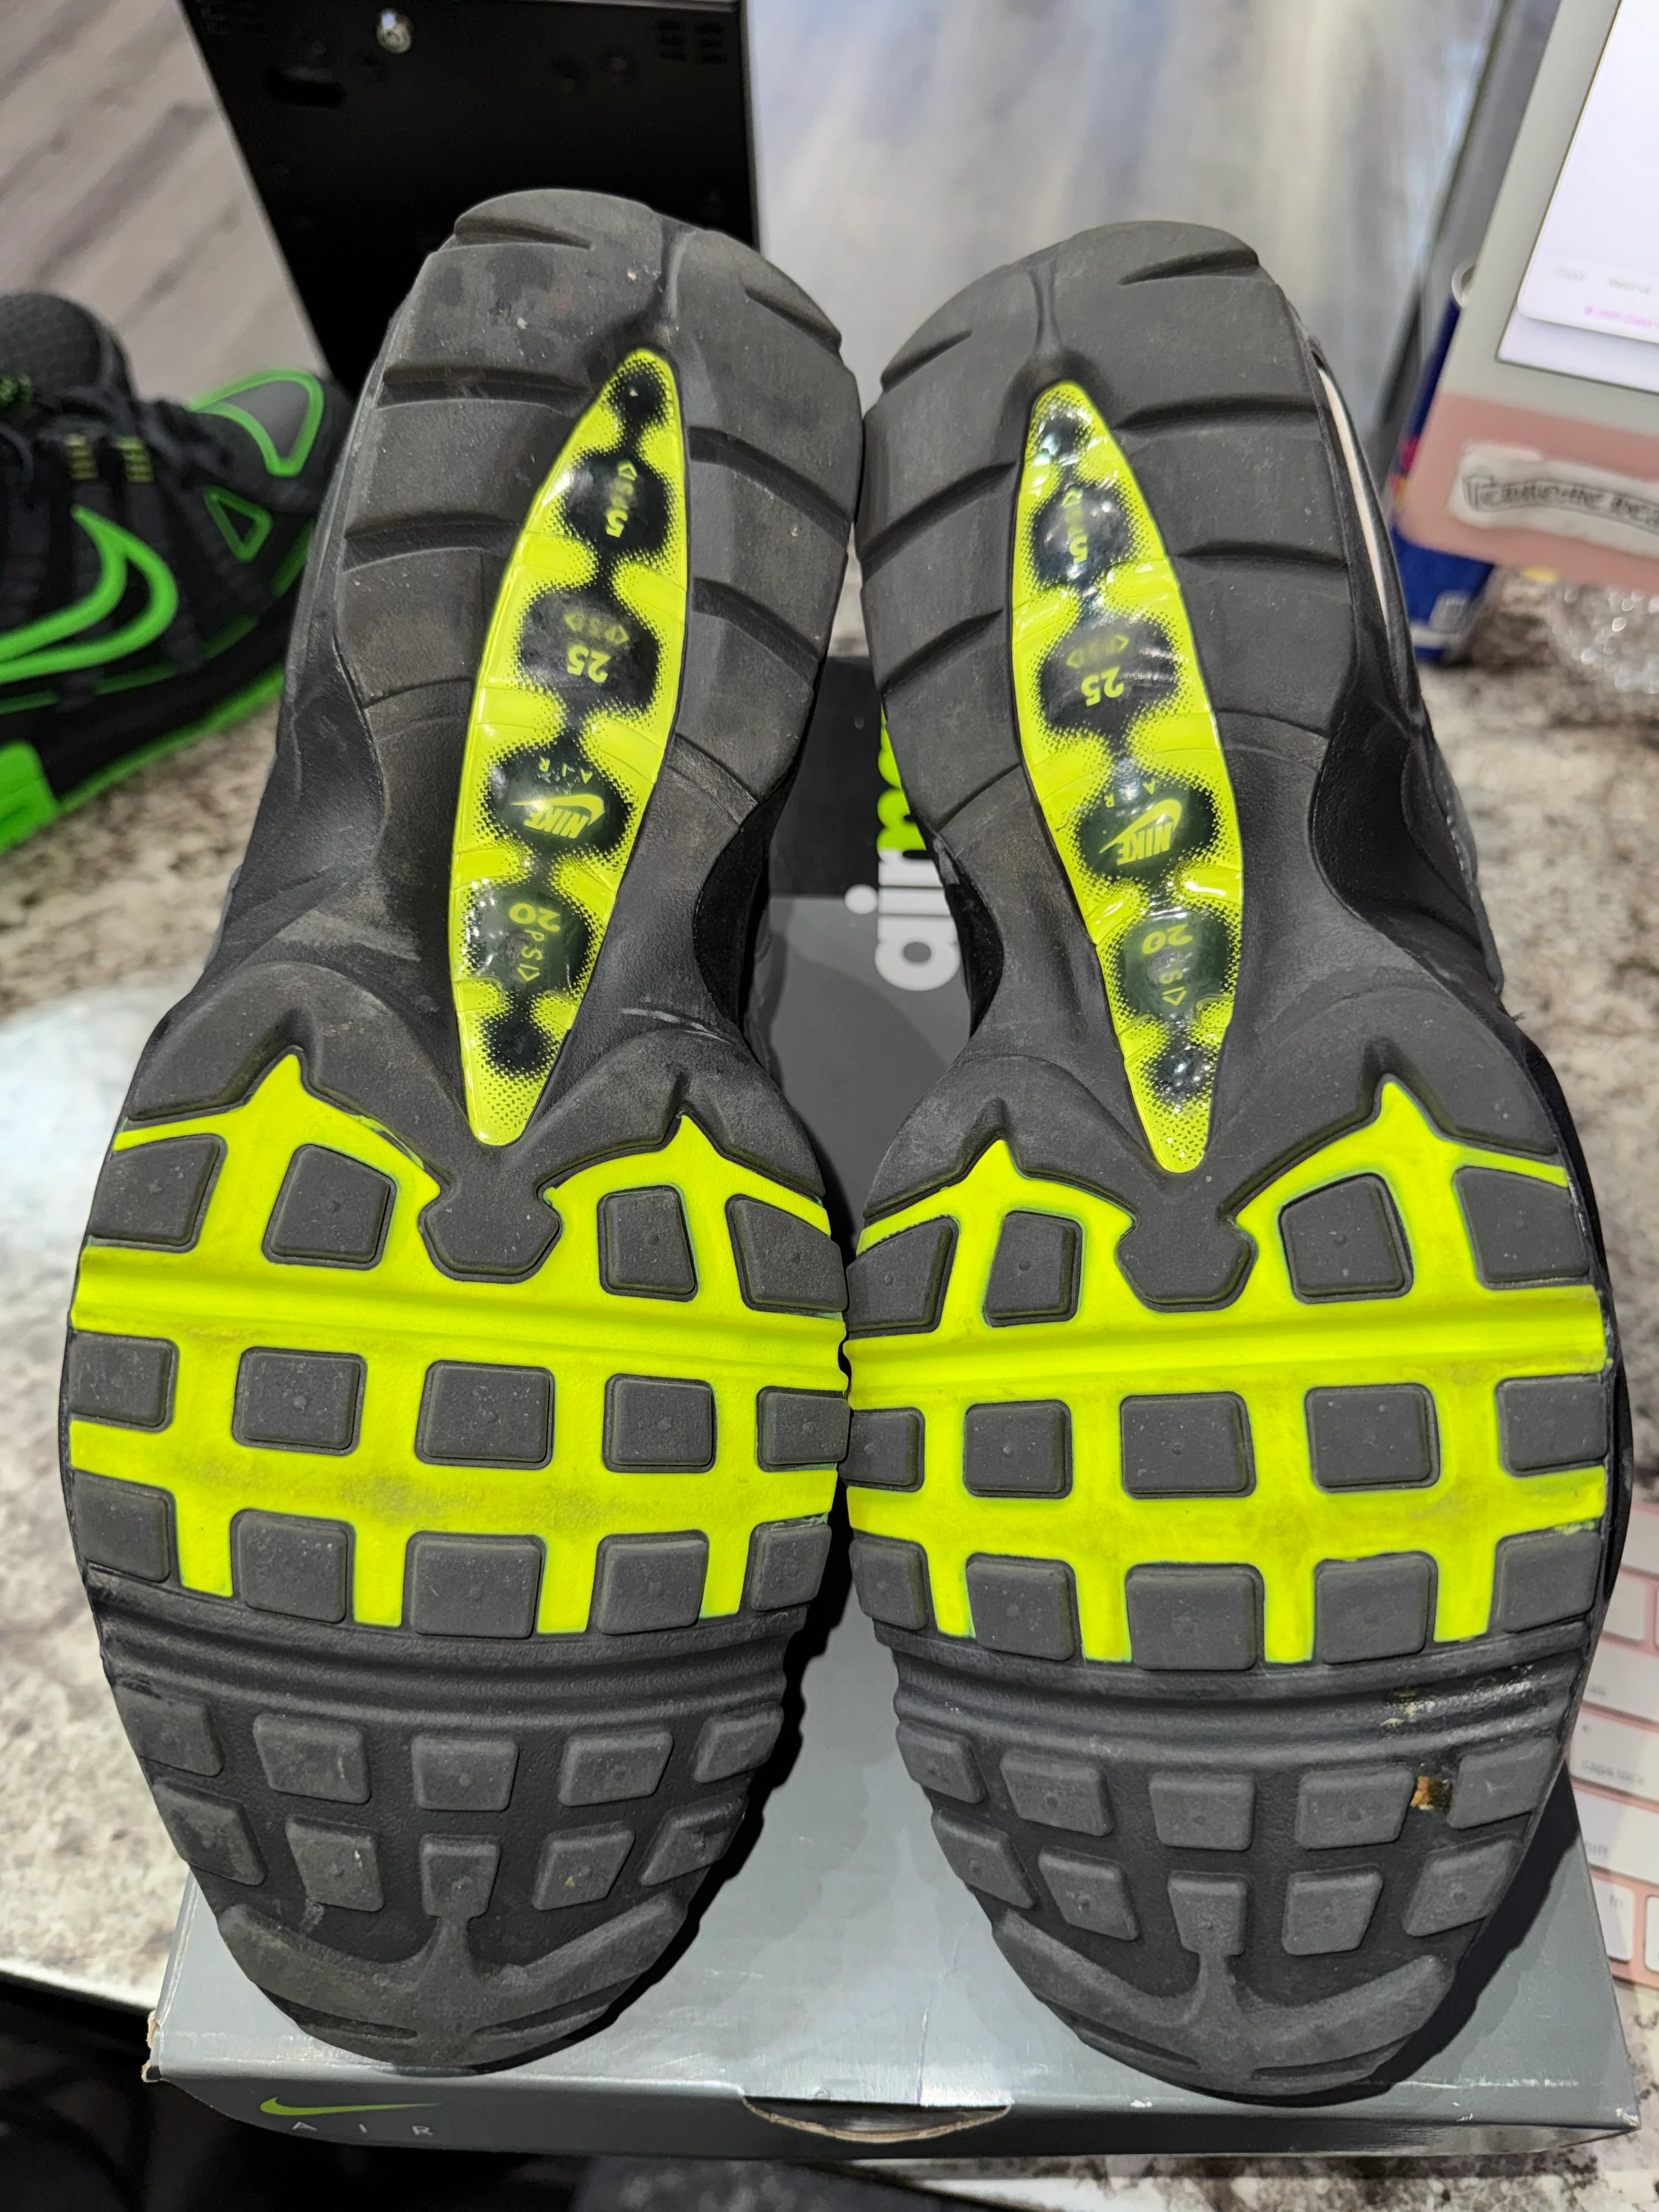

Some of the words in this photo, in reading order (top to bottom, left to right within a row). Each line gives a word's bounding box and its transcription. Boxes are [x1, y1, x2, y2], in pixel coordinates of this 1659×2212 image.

[605, 509, 628, 538] 5
[1069, 534, 1088, 563] 5
[567, 644, 611, 684] 25
[1080, 664, 1125, 707] 25
[538, 757, 593, 785] AIR
[1104, 778, 1156, 808] AR
[523, 805, 589, 839] NIKE
[1115, 822, 1172, 866] NIKE
[509, 901, 561, 933] 20
[1142, 923, 1193, 955] 20
[291, 2121, 434, 2136] AIR
